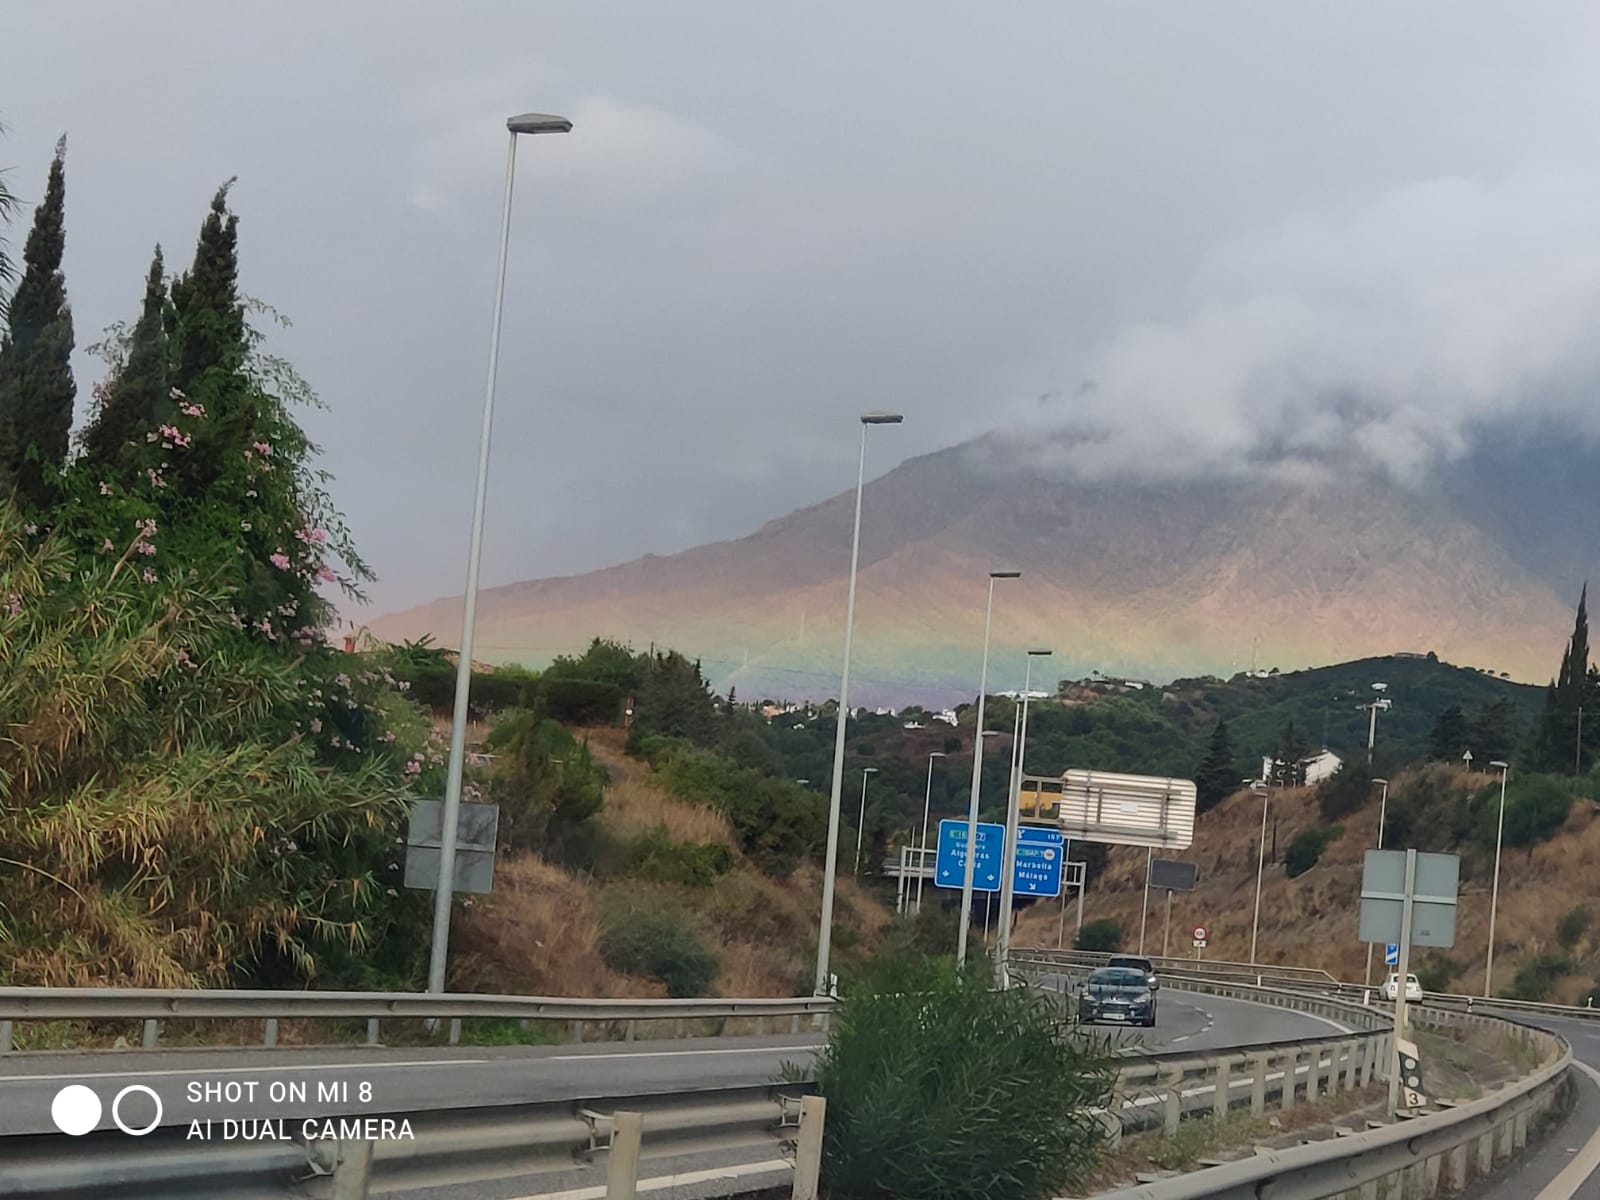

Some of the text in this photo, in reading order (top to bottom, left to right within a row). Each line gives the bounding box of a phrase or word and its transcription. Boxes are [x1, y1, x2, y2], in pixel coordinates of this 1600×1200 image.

[950, 849, 990, 859] Algeras
[1016, 860, 1053, 871] Marbella
[1408, 1092, 1419, 1105] 3
